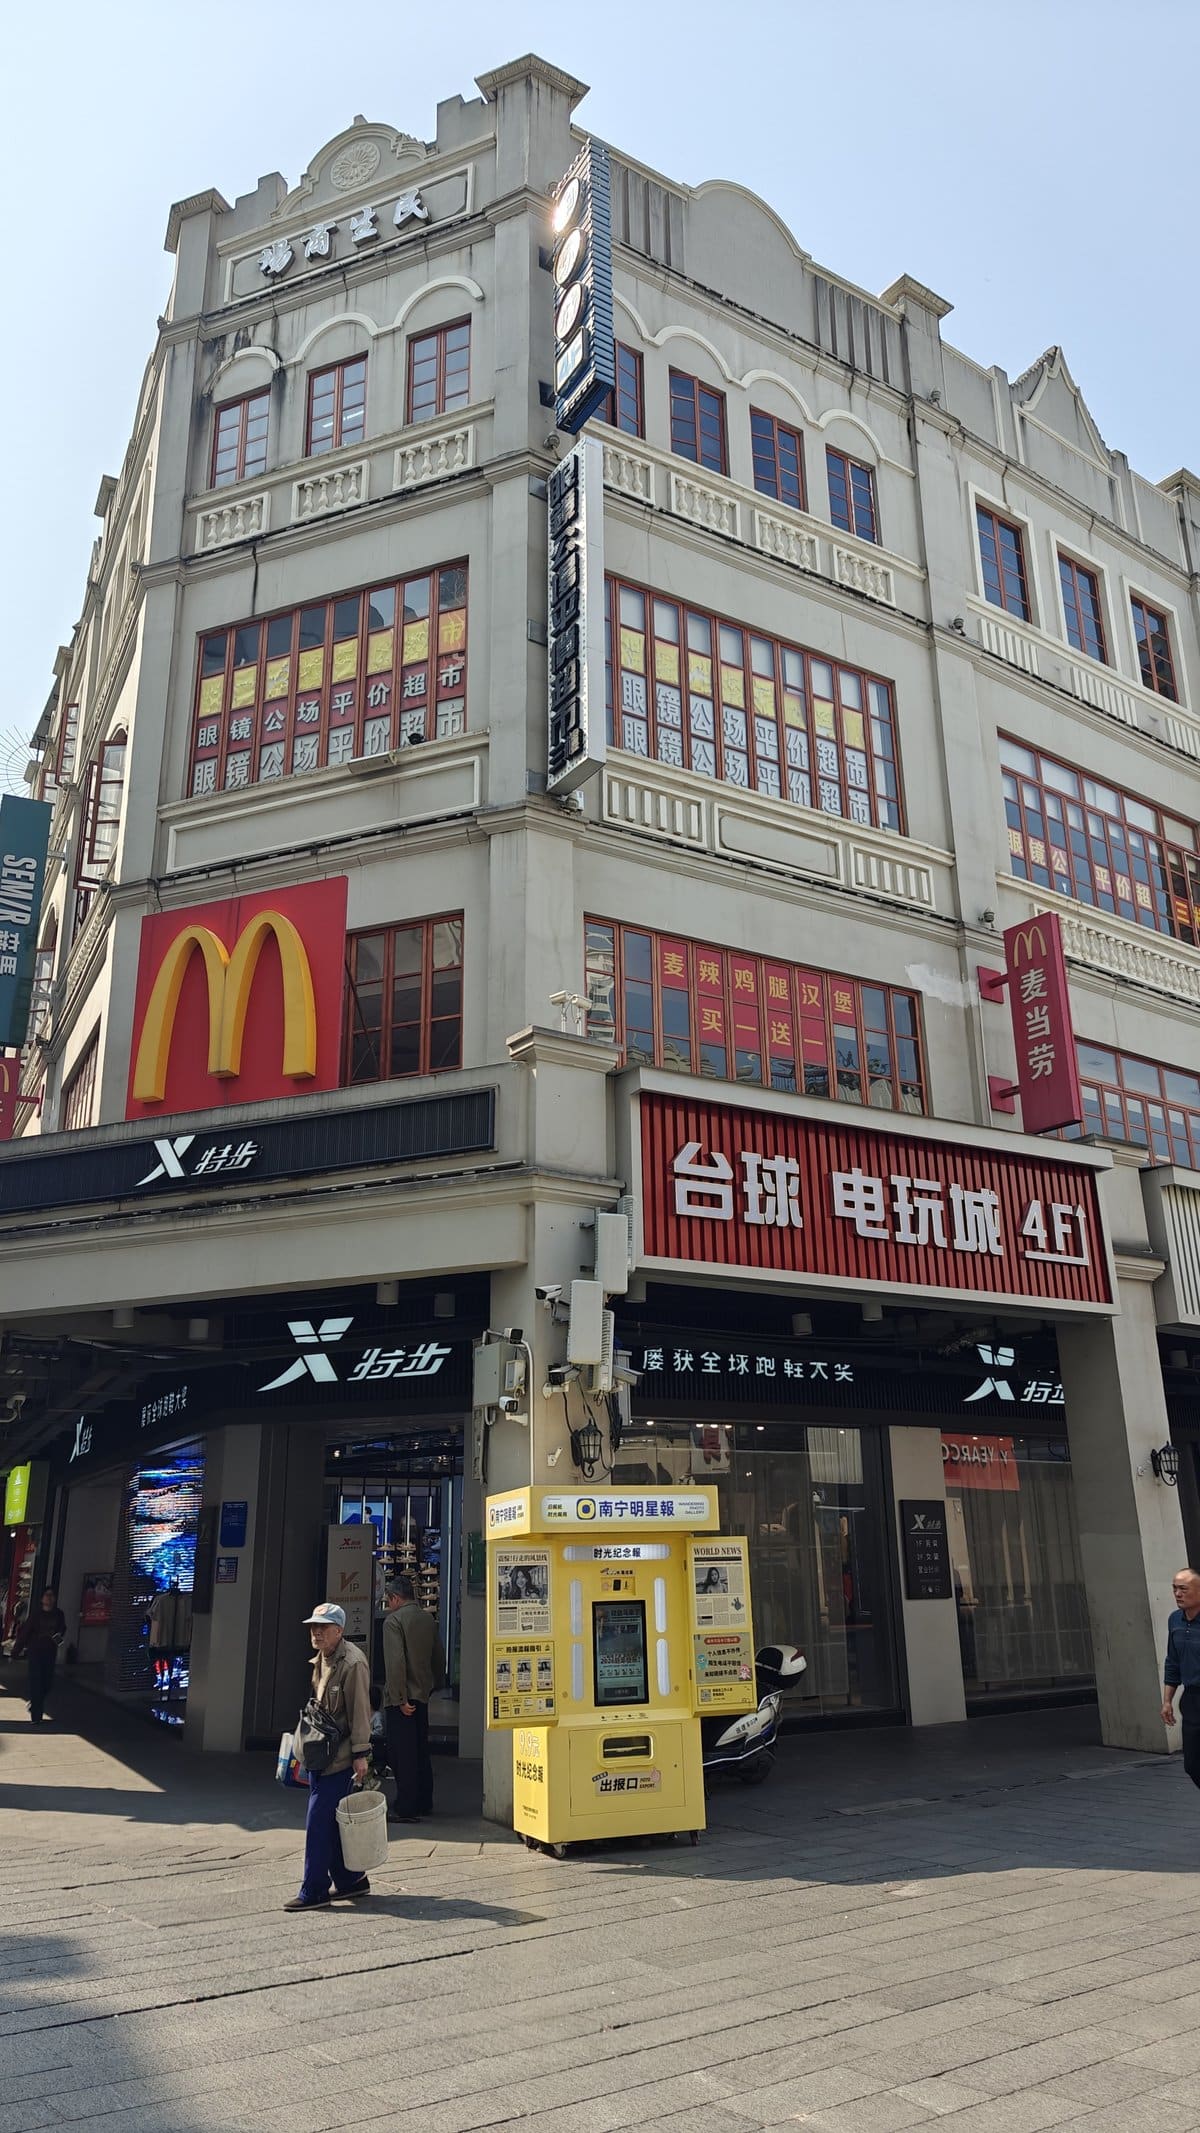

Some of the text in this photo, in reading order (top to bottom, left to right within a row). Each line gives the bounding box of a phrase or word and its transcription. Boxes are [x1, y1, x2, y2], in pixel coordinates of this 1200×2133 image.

[197, 664, 464, 748] 眼镜公场平价超市
[622, 678, 867, 786] 眼镜公场平价超市
[193, 703, 464, 796] 眼镜公场平价超市
[623, 718, 869, 824] 眼镜公场平价超市
[0, 855, 37, 926] SEMIR
[663, 952, 854, 1015] 麦辣鸡腿汉堡
[702, 1007, 824, 1047] 买一送一
[1020, 967, 1056, 1081] 麦当劳
[190, 1140, 258, 1176] 特步
[672, 1141, 1074, 1256] 台球 电玩城 4F
[346, 1342, 453, 1382] 特步
[598, 1500, 676, 1518] 南宁明星報
[593, 1547, 642, 1559] 时光纪念報
[694, 1546, 742, 1556] WORLD NEWS
[600, 1777, 639, 1793] 出报口
